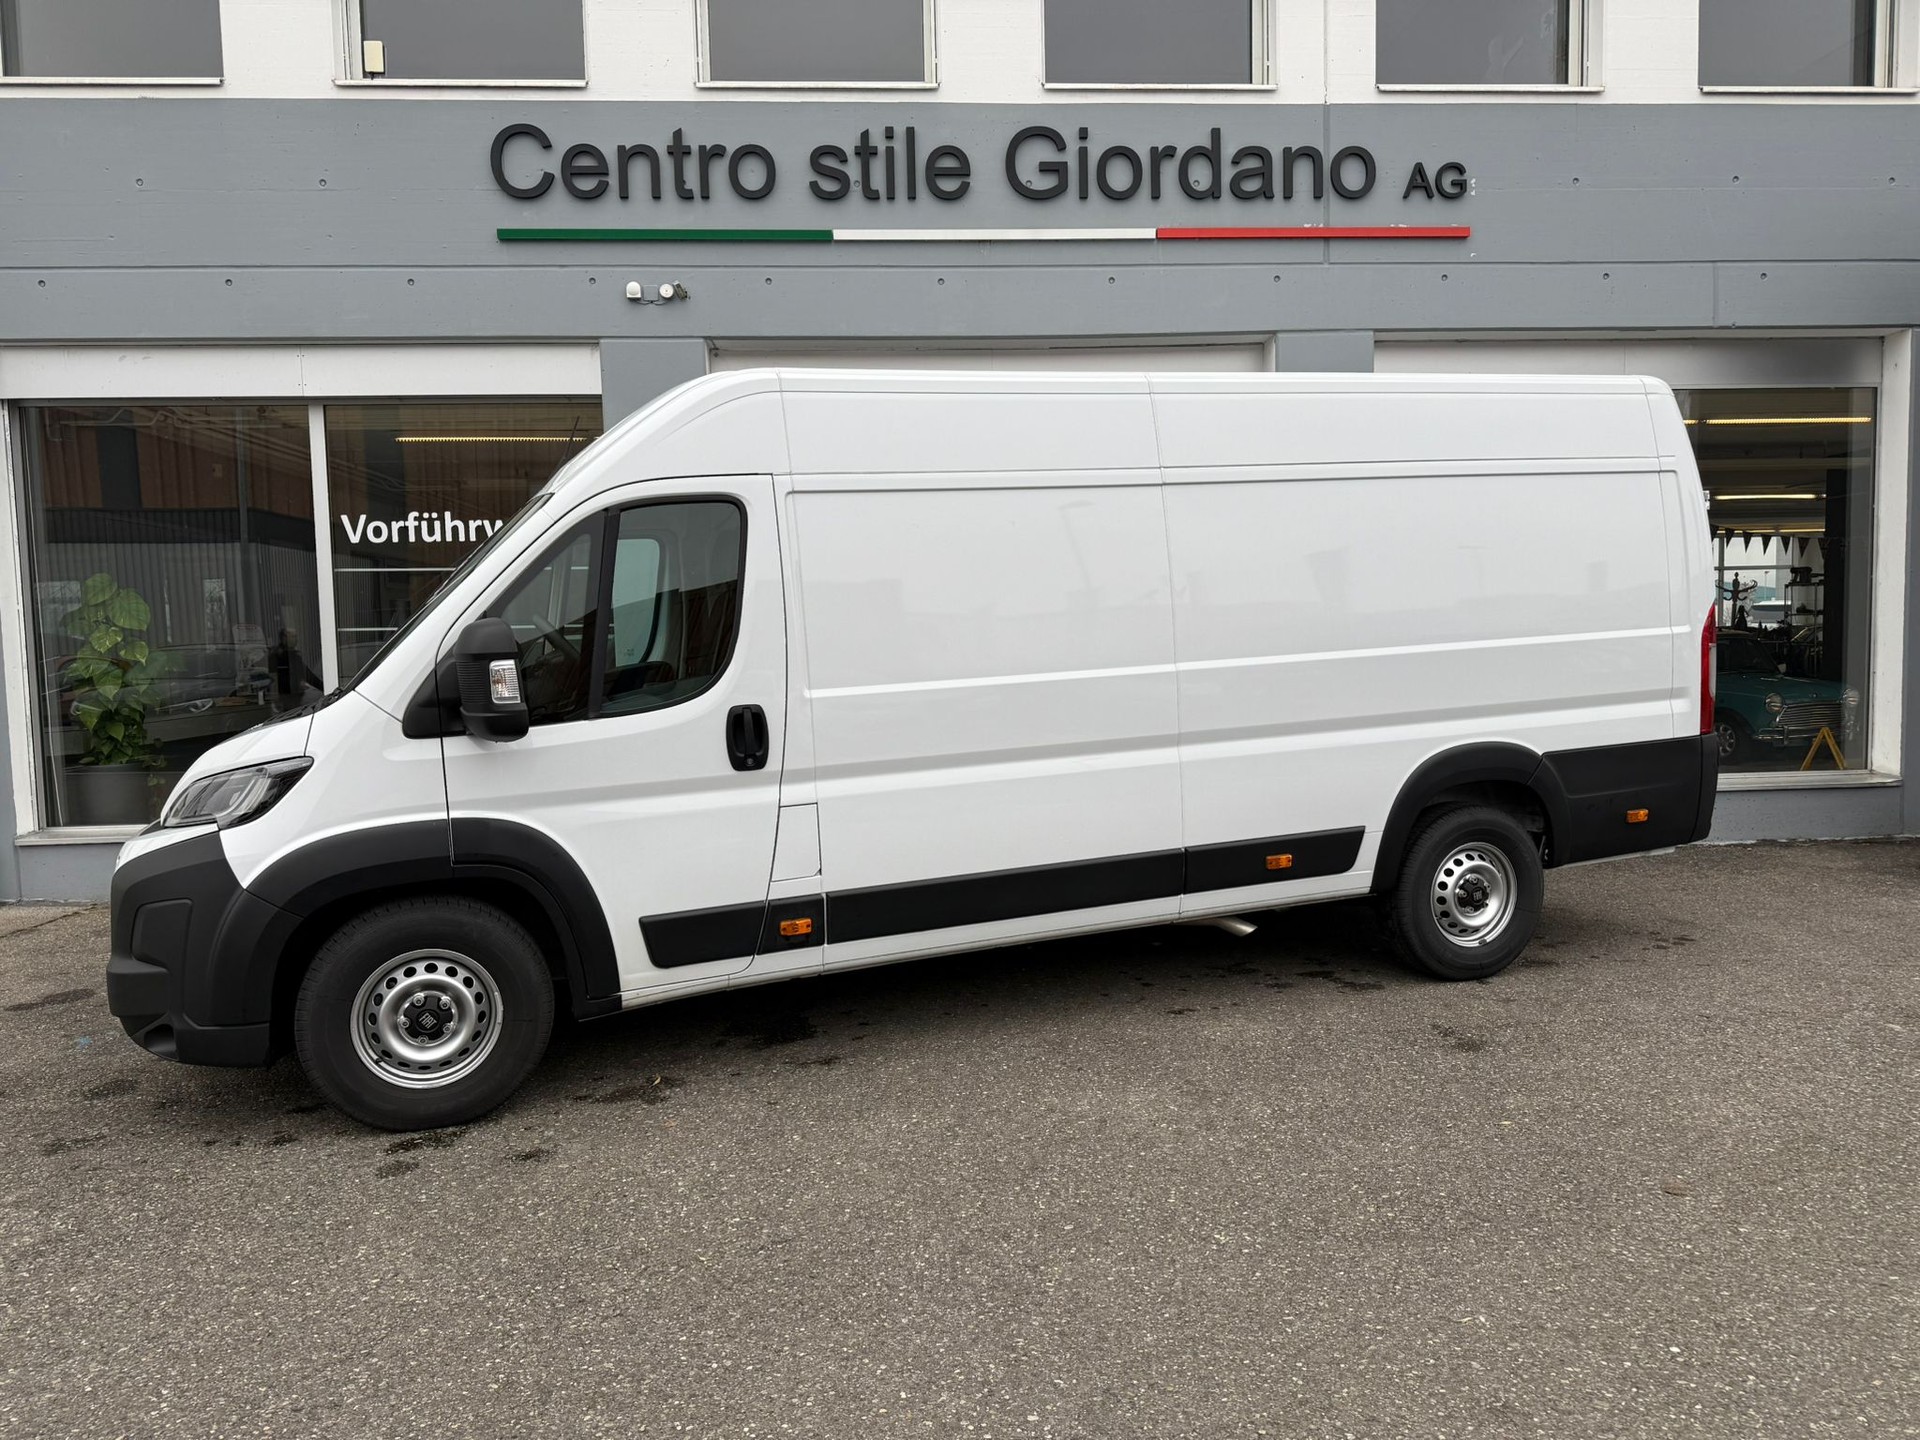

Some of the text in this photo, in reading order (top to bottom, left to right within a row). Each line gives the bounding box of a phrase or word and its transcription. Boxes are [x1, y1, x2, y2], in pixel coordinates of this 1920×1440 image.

[490, 123, 1467, 199] Centro stile Giordano AG
[419, 1012, 438, 1029] FIAT
